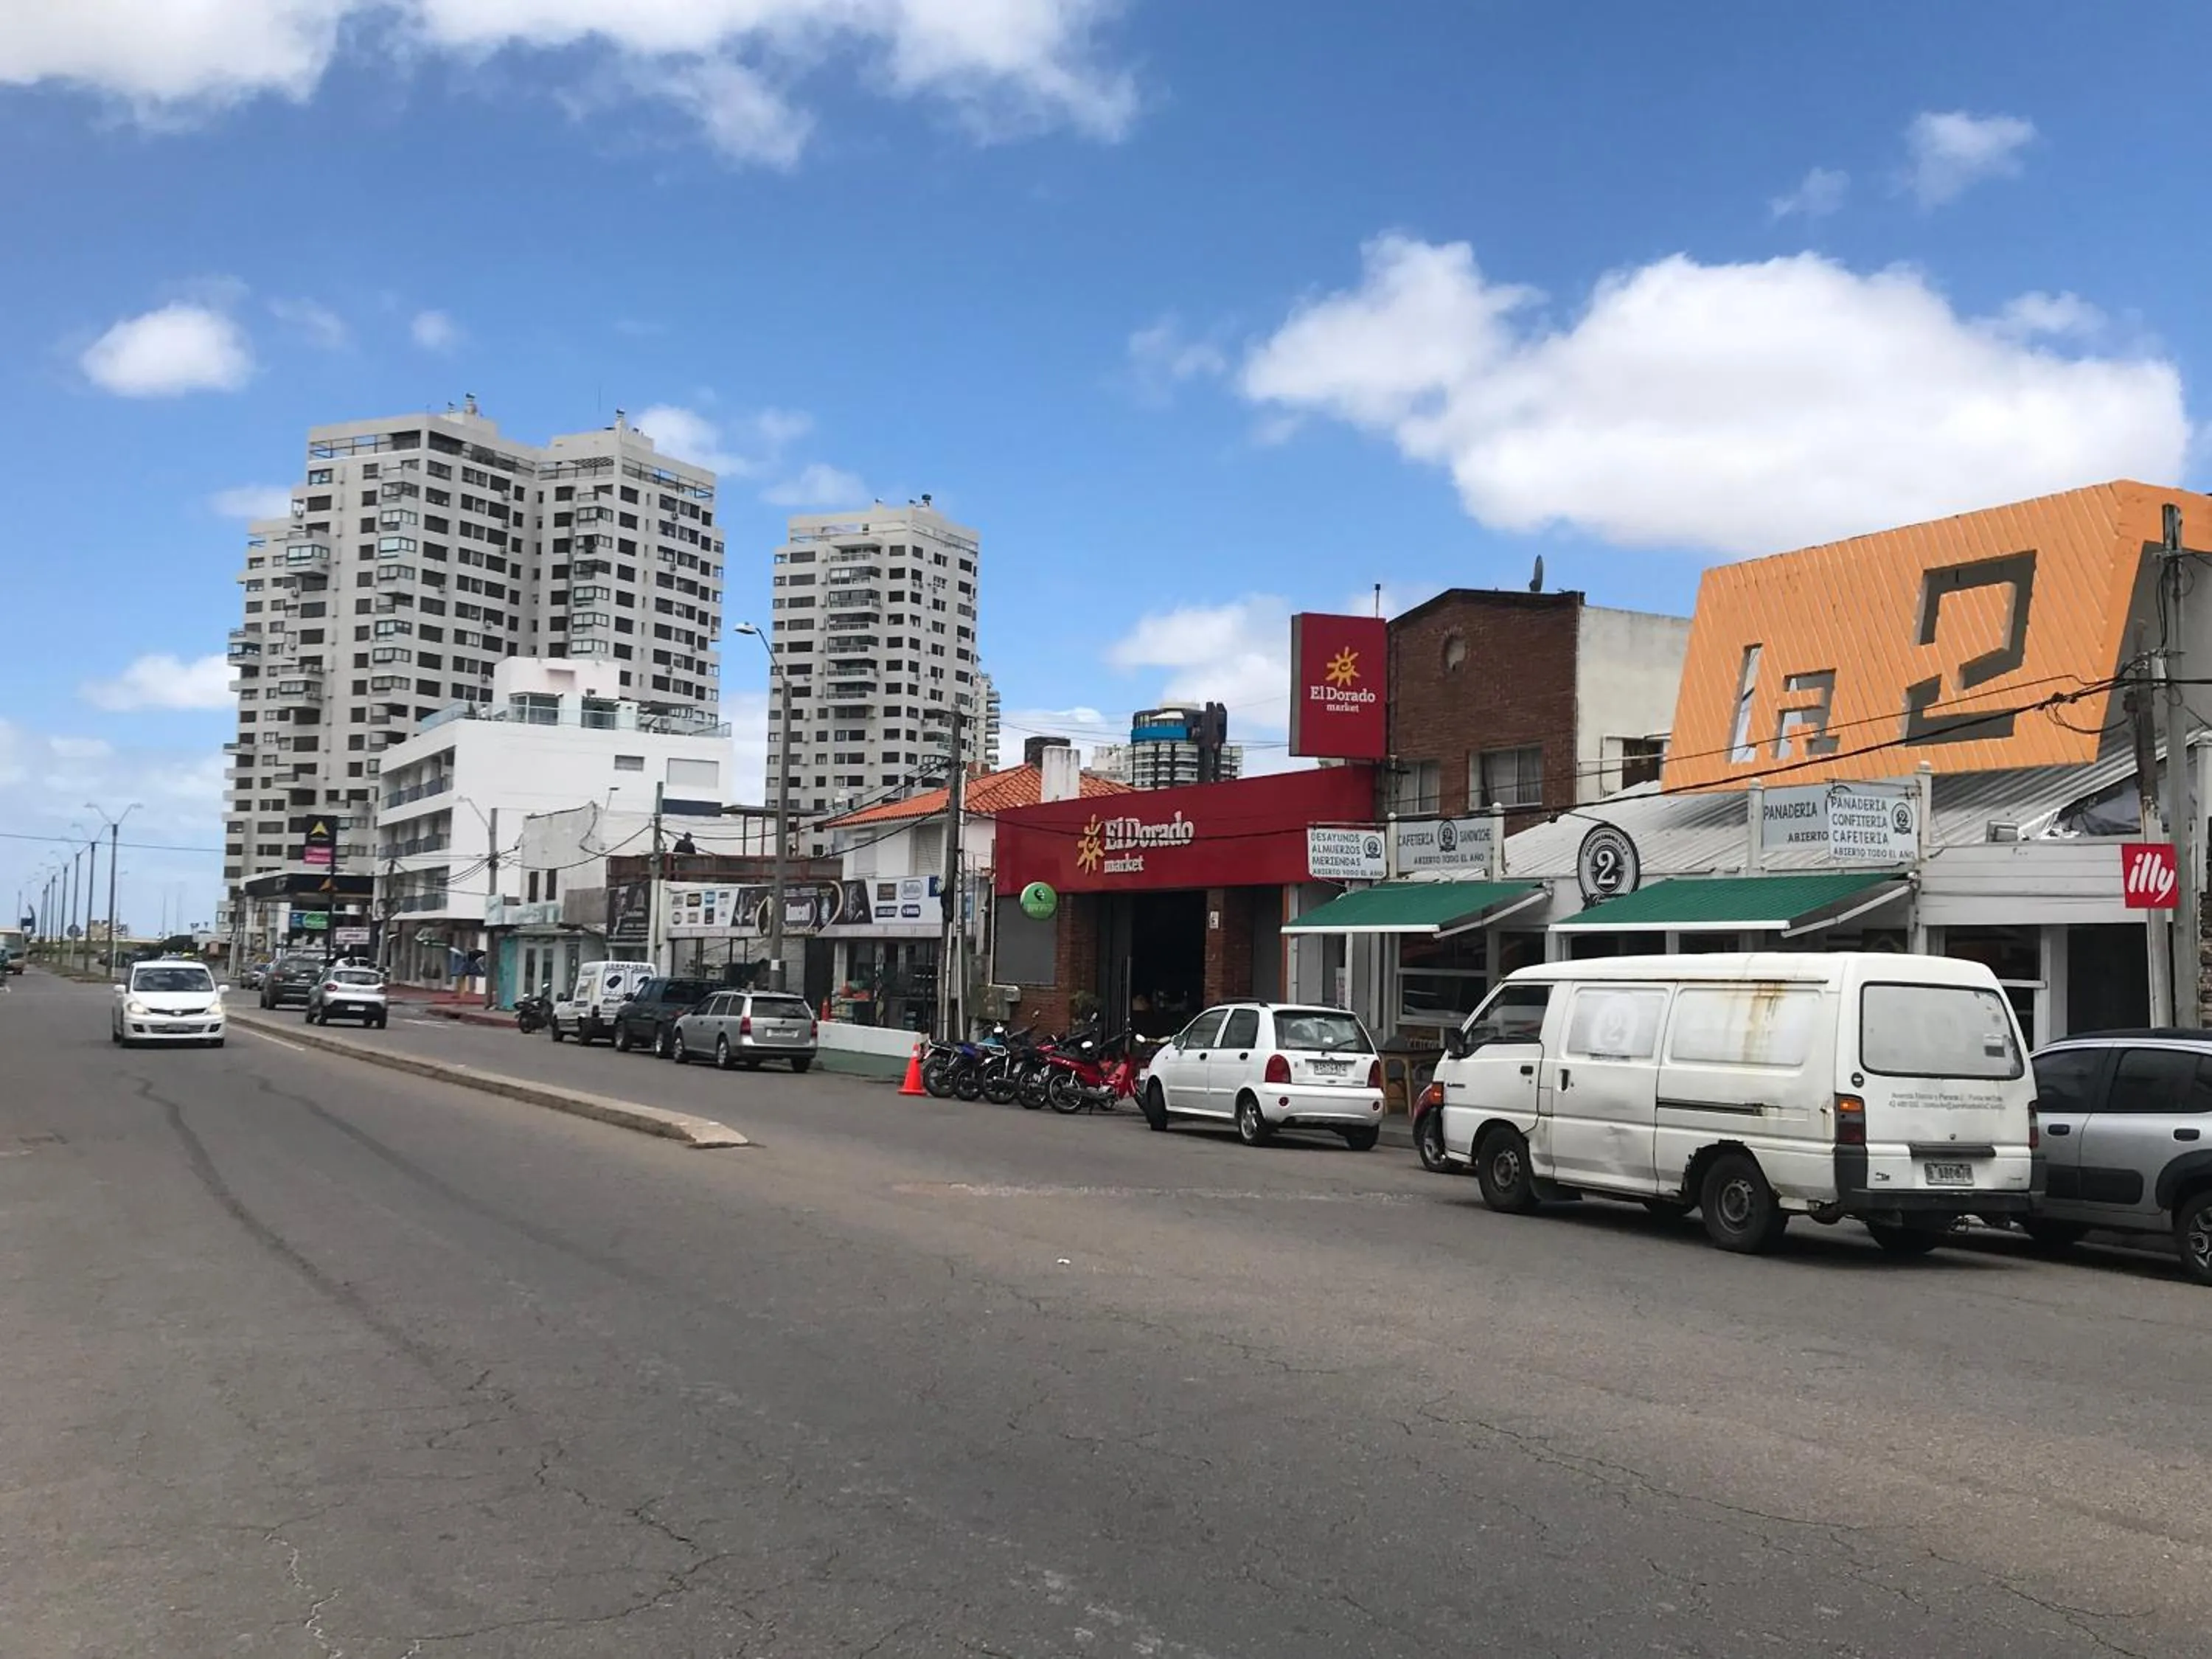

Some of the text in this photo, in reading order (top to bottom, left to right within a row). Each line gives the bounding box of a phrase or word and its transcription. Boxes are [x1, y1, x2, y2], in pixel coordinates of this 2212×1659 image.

[1310, 686, 1376, 703] El Dorado
[1326, 702, 1359, 712] market
[1763, 801, 1817, 821] PANADERIA
[1832, 796, 1887, 812] PANADERIA
[1832, 813, 1888, 828] CONFITERIA
[1105, 810, 1194, 850] El Dorado
[1311, 831, 1360, 843] DESAYUNOS
[1787, 831, 1829, 844] ABIERTO
[1832, 831, 1889, 844] CAFETERIA
[1312, 844, 1360, 855] ALMUERZOS
[1833, 847, 1866, 858] ABIERTO
[1868, 849, 1886, 858] TODO
[1888, 850, 1897, 858] EL
[1105, 853, 1144, 873] market
[1312, 856, 1361, 866] MERIENDAS
[1596, 850, 1616, 884] 2
[2128, 852, 2175, 902] illy
